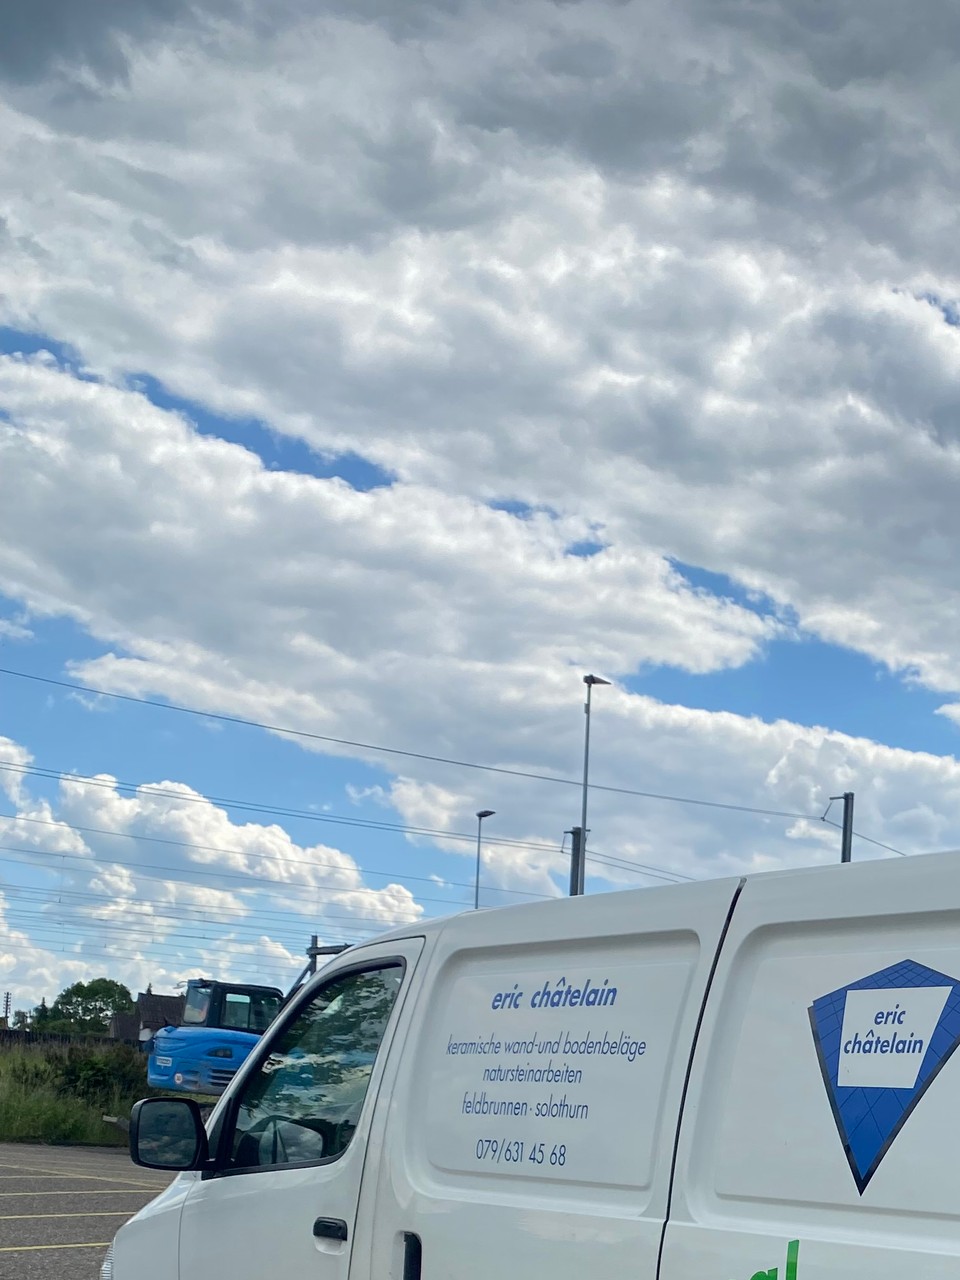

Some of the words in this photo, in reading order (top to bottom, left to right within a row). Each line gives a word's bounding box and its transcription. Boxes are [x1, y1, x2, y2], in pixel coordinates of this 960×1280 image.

[491, 984, 523, 1010] eric
[530, 976, 618, 1008] châtelain
[874, 1004, 906, 1025] eric
[446, 1033, 501, 1055] keramische
[563, 1031, 647, 1062] bodenbeläge
[843, 1029, 924, 1055] châtelain
[483, 1060, 582, 1083] natursteinarbeiten
[462, 1092, 527, 1116] feldbrunnen
[535, 1093, 588, 1119] solothurn
[476, 1139, 524, 1164] 079/631
[528, 1143, 545, 1165] 45
[550, 1145, 566, 1166] 68
